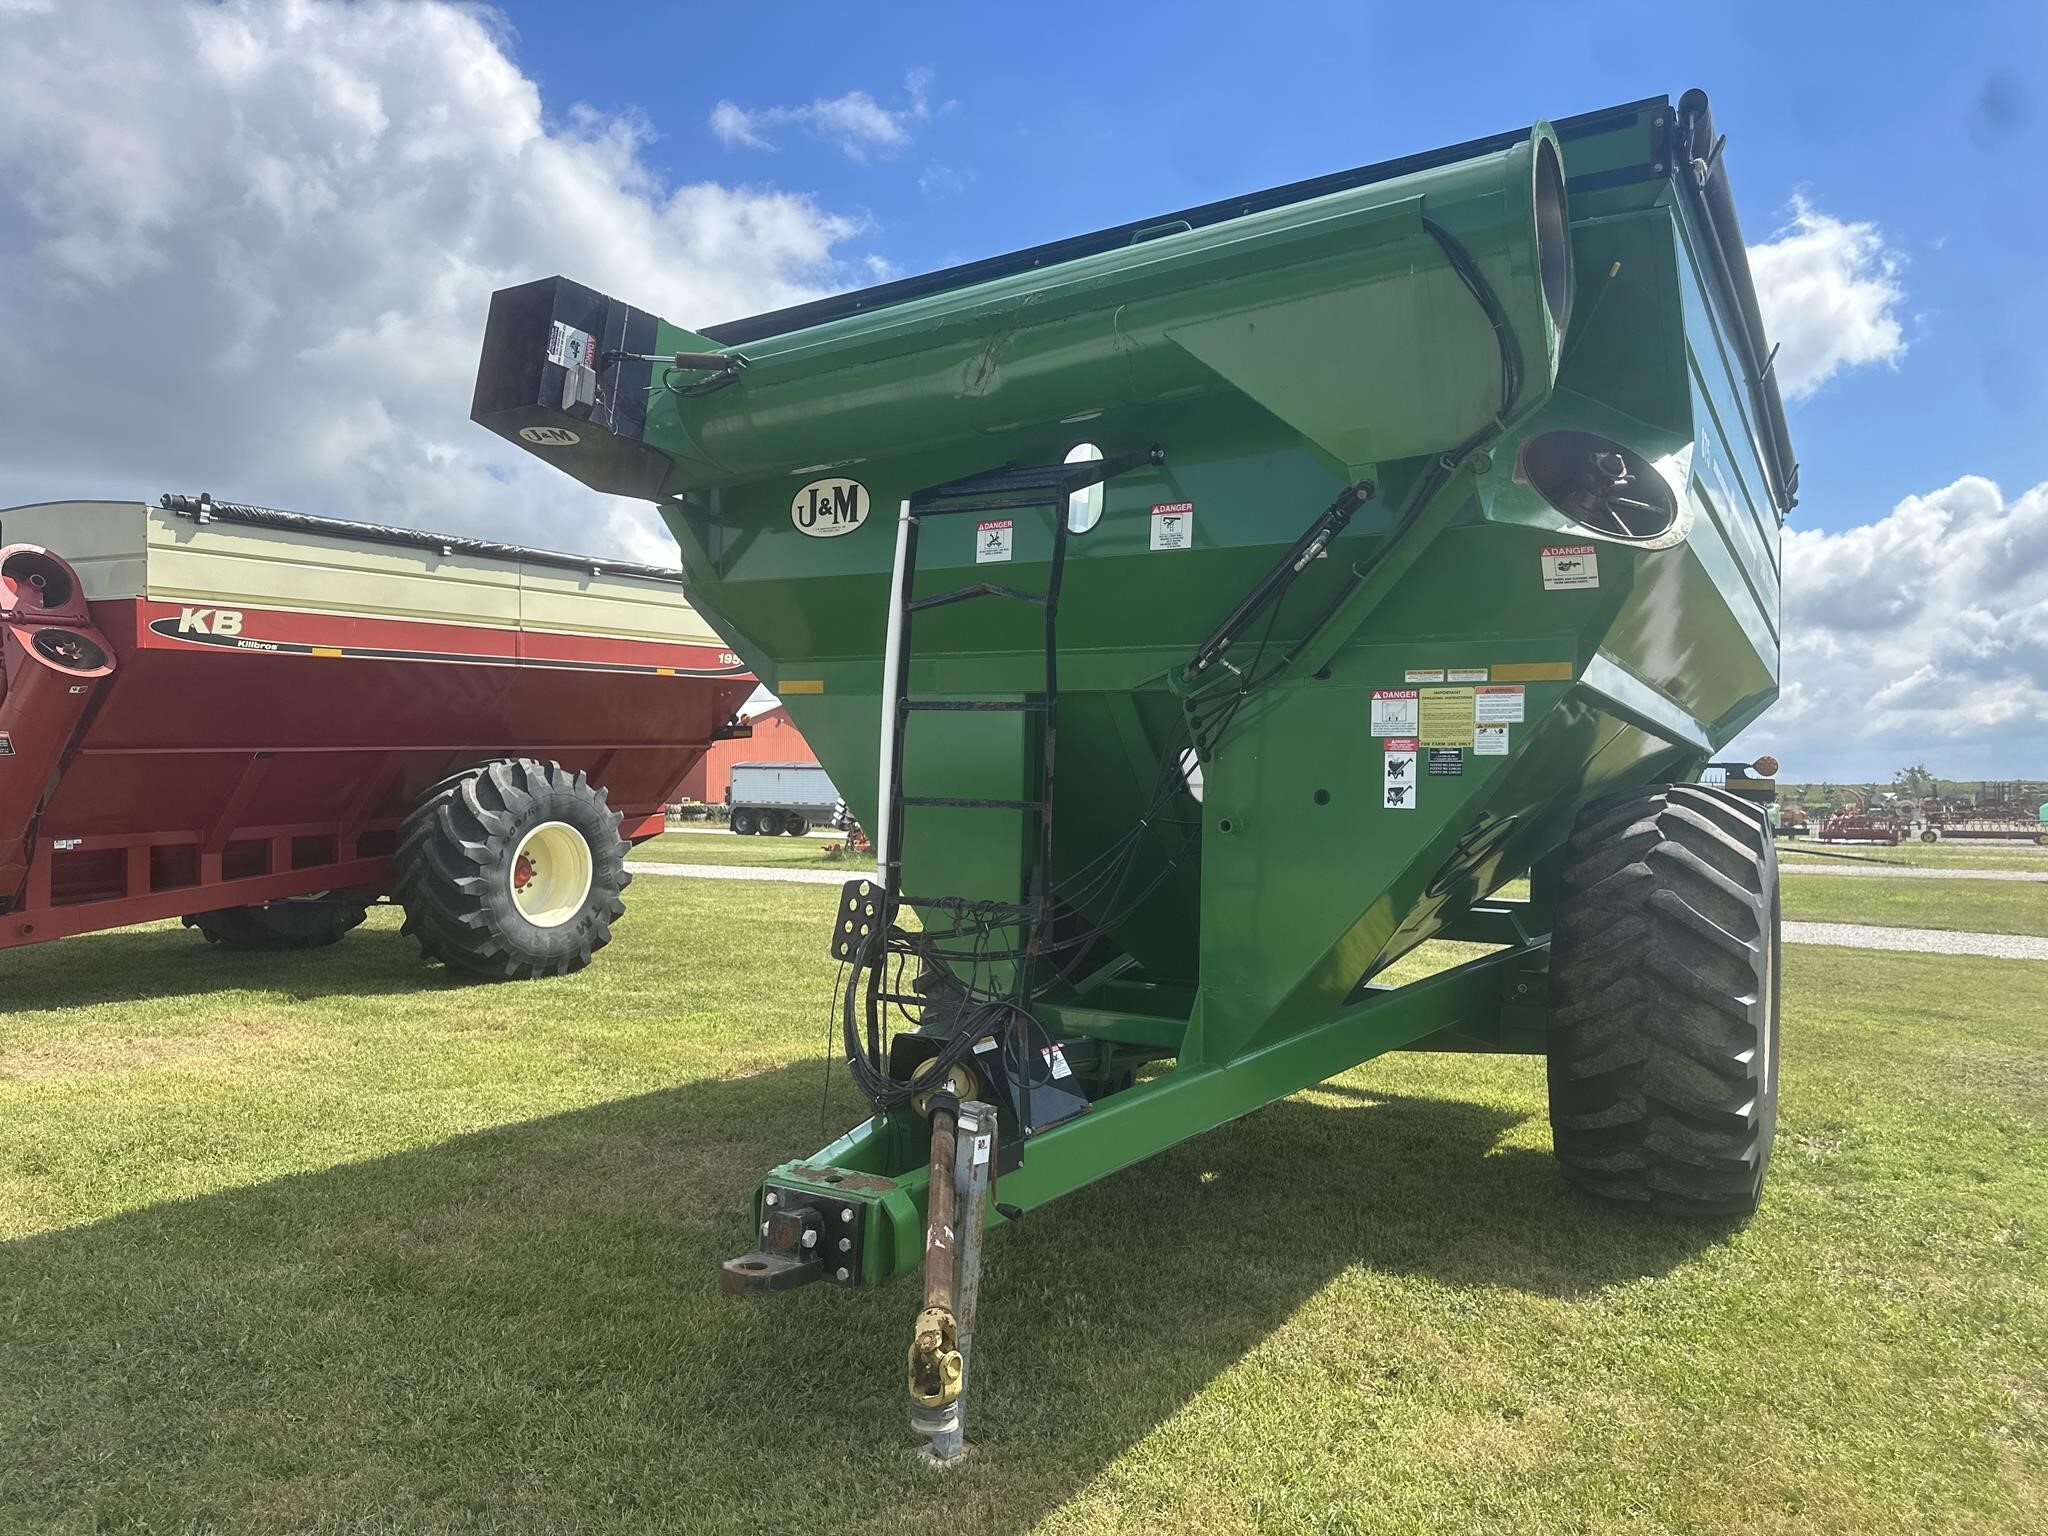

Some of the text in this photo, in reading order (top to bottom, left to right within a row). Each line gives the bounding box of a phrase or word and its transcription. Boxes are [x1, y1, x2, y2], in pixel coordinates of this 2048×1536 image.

[585, 342, 597, 368] DANG
[524, 429, 575, 442] J&M
[797, 484, 859, 528] J&M
[1160, 503, 1192, 513] DANGER
[984, 520, 1012, 529] DANGER
[1551, 546, 1594, 555] DANGER
[178, 607, 243, 635] KB
[237, 640, 278, 650] Killbros
[718, 653, 744, 665] 195
[1382, 690, 1417, 699] DANGER
